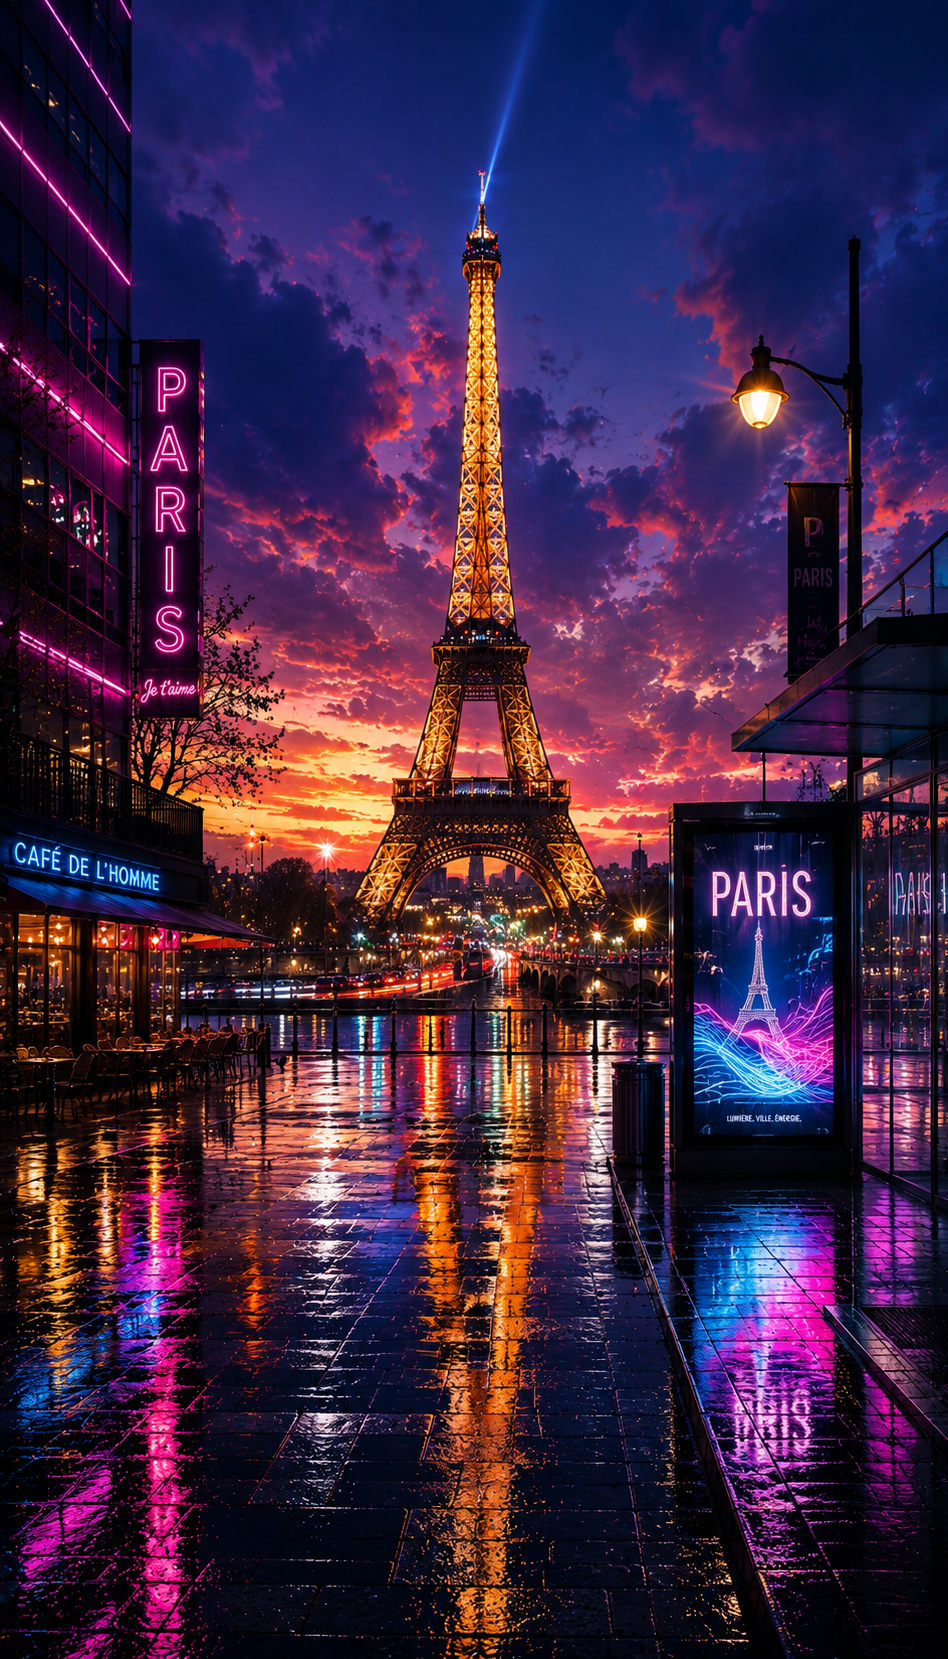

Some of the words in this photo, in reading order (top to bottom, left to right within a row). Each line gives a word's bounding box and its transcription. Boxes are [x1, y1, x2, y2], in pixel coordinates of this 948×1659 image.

[150, 366, 188, 653] PARIS
[793, 567, 833, 588] PARIS
[140, 678, 158, 703] Je
[160, 679, 197, 696] t'aime
[14, 842, 61, 872] CAFÉ
[69, 854, 90, 877] DE
[96, 860, 160, 892] L'HOMME
